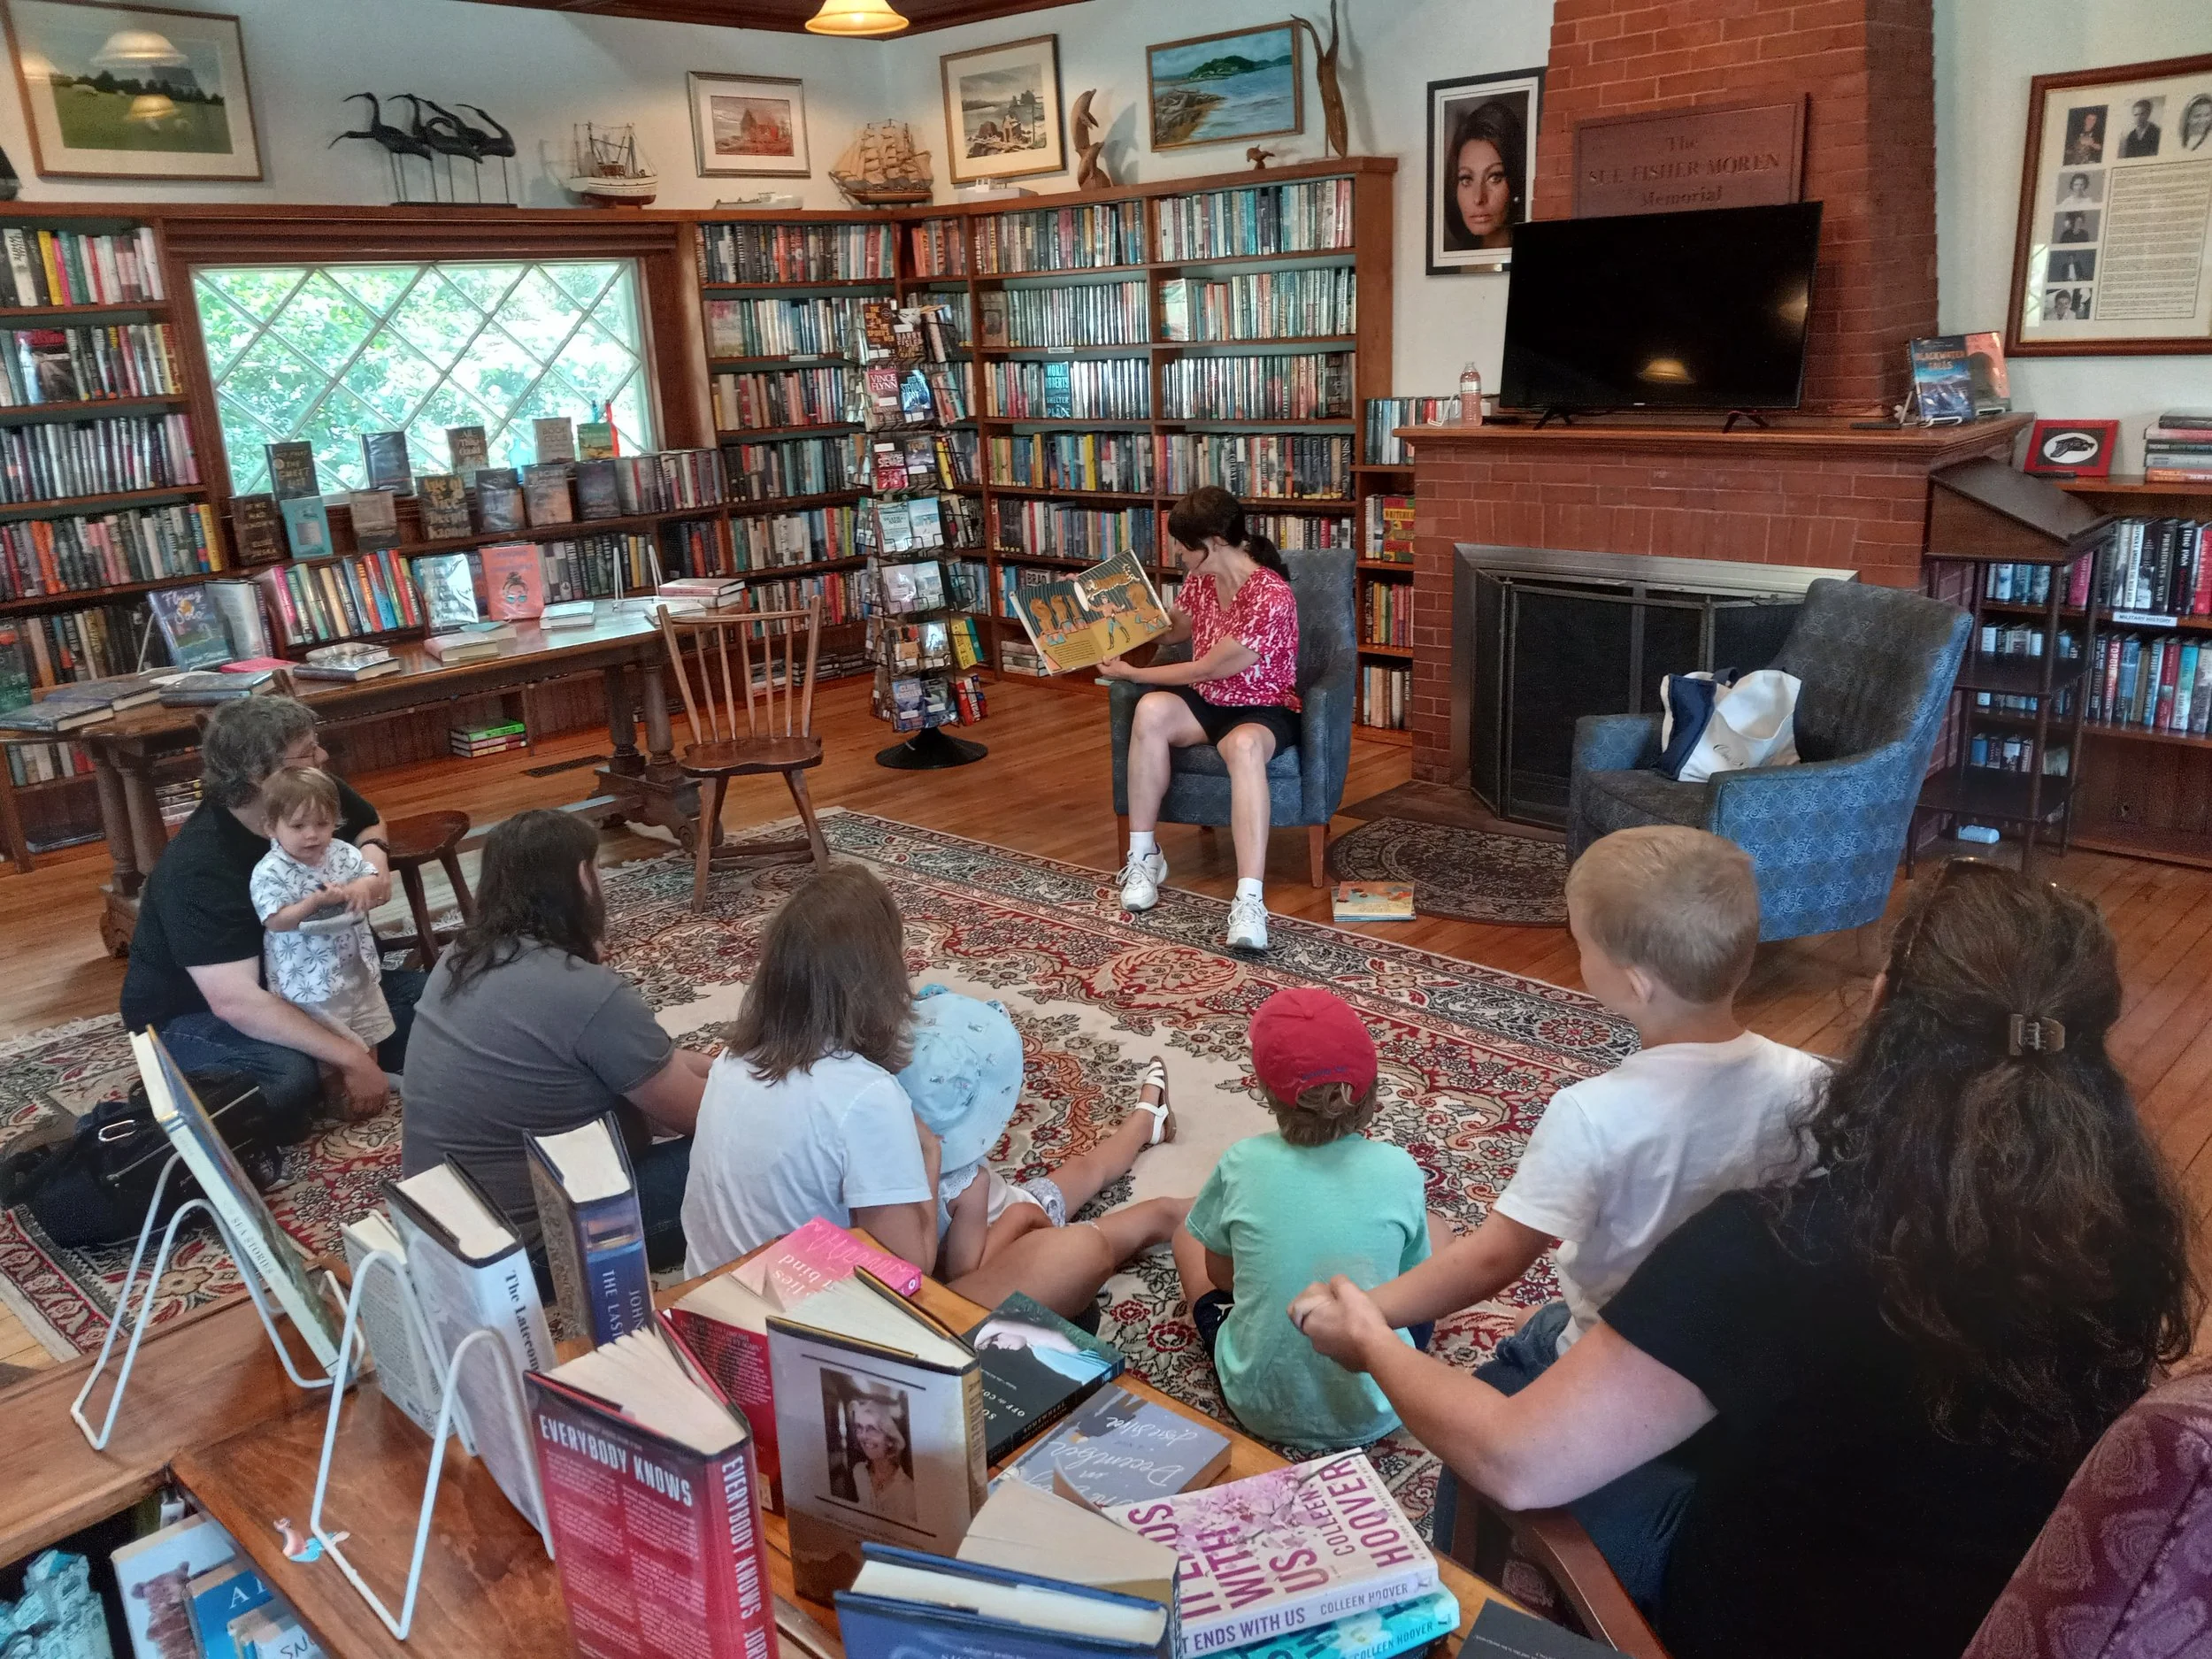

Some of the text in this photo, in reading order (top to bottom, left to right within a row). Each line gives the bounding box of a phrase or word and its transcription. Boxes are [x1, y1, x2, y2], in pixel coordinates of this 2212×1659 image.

[1640, 184, 1724, 207] Memorial
[870, 374, 896, 383] VINCE
[871, 381, 898, 390] FLYNN
[2158, 534, 2171, 578] PRESIDENTS
[1027, 573, 1047, 585] BRAD
[231, 1216, 277, 1274] SEA STORIES
[504, 1269, 520, 1302] The
[602, 1269, 618, 1298] THE
[772, 1269, 806, 1297] lies
[777, 1253, 823, 1283] bind
[628, 1289, 647, 1330] JOHN
[1004, 1401, 1026, 1418] OFF
[538, 1415, 627, 1473] EVERYBODY
[633, 1455, 693, 1508] KNOWS
[1047, 1443, 1184, 1487] December
[721, 1455, 755, 1555] EVERYBODY
[1298, 1489, 1356, 1557] COLLEEN
[1320, 1460, 1416, 1568] HOOVER
[734, 1554, 763, 1620] KNOWS
[1202, 1525, 1274, 1609] WITH
[1269, 1548, 1331, 1594] US
[1194, 1625, 1236, 1650] ENDS
[1240, 1615, 1280, 1640] WITH
[1286, 1608, 1306, 1625] US
[1320, 1595, 1365, 1617] COLLEEN
[1368, 1583, 1409, 1604] HOOVER
[1352, 1638, 1394, 1659] COLLEEN
[1396, 1621, 1433, 1647] HOOVER
